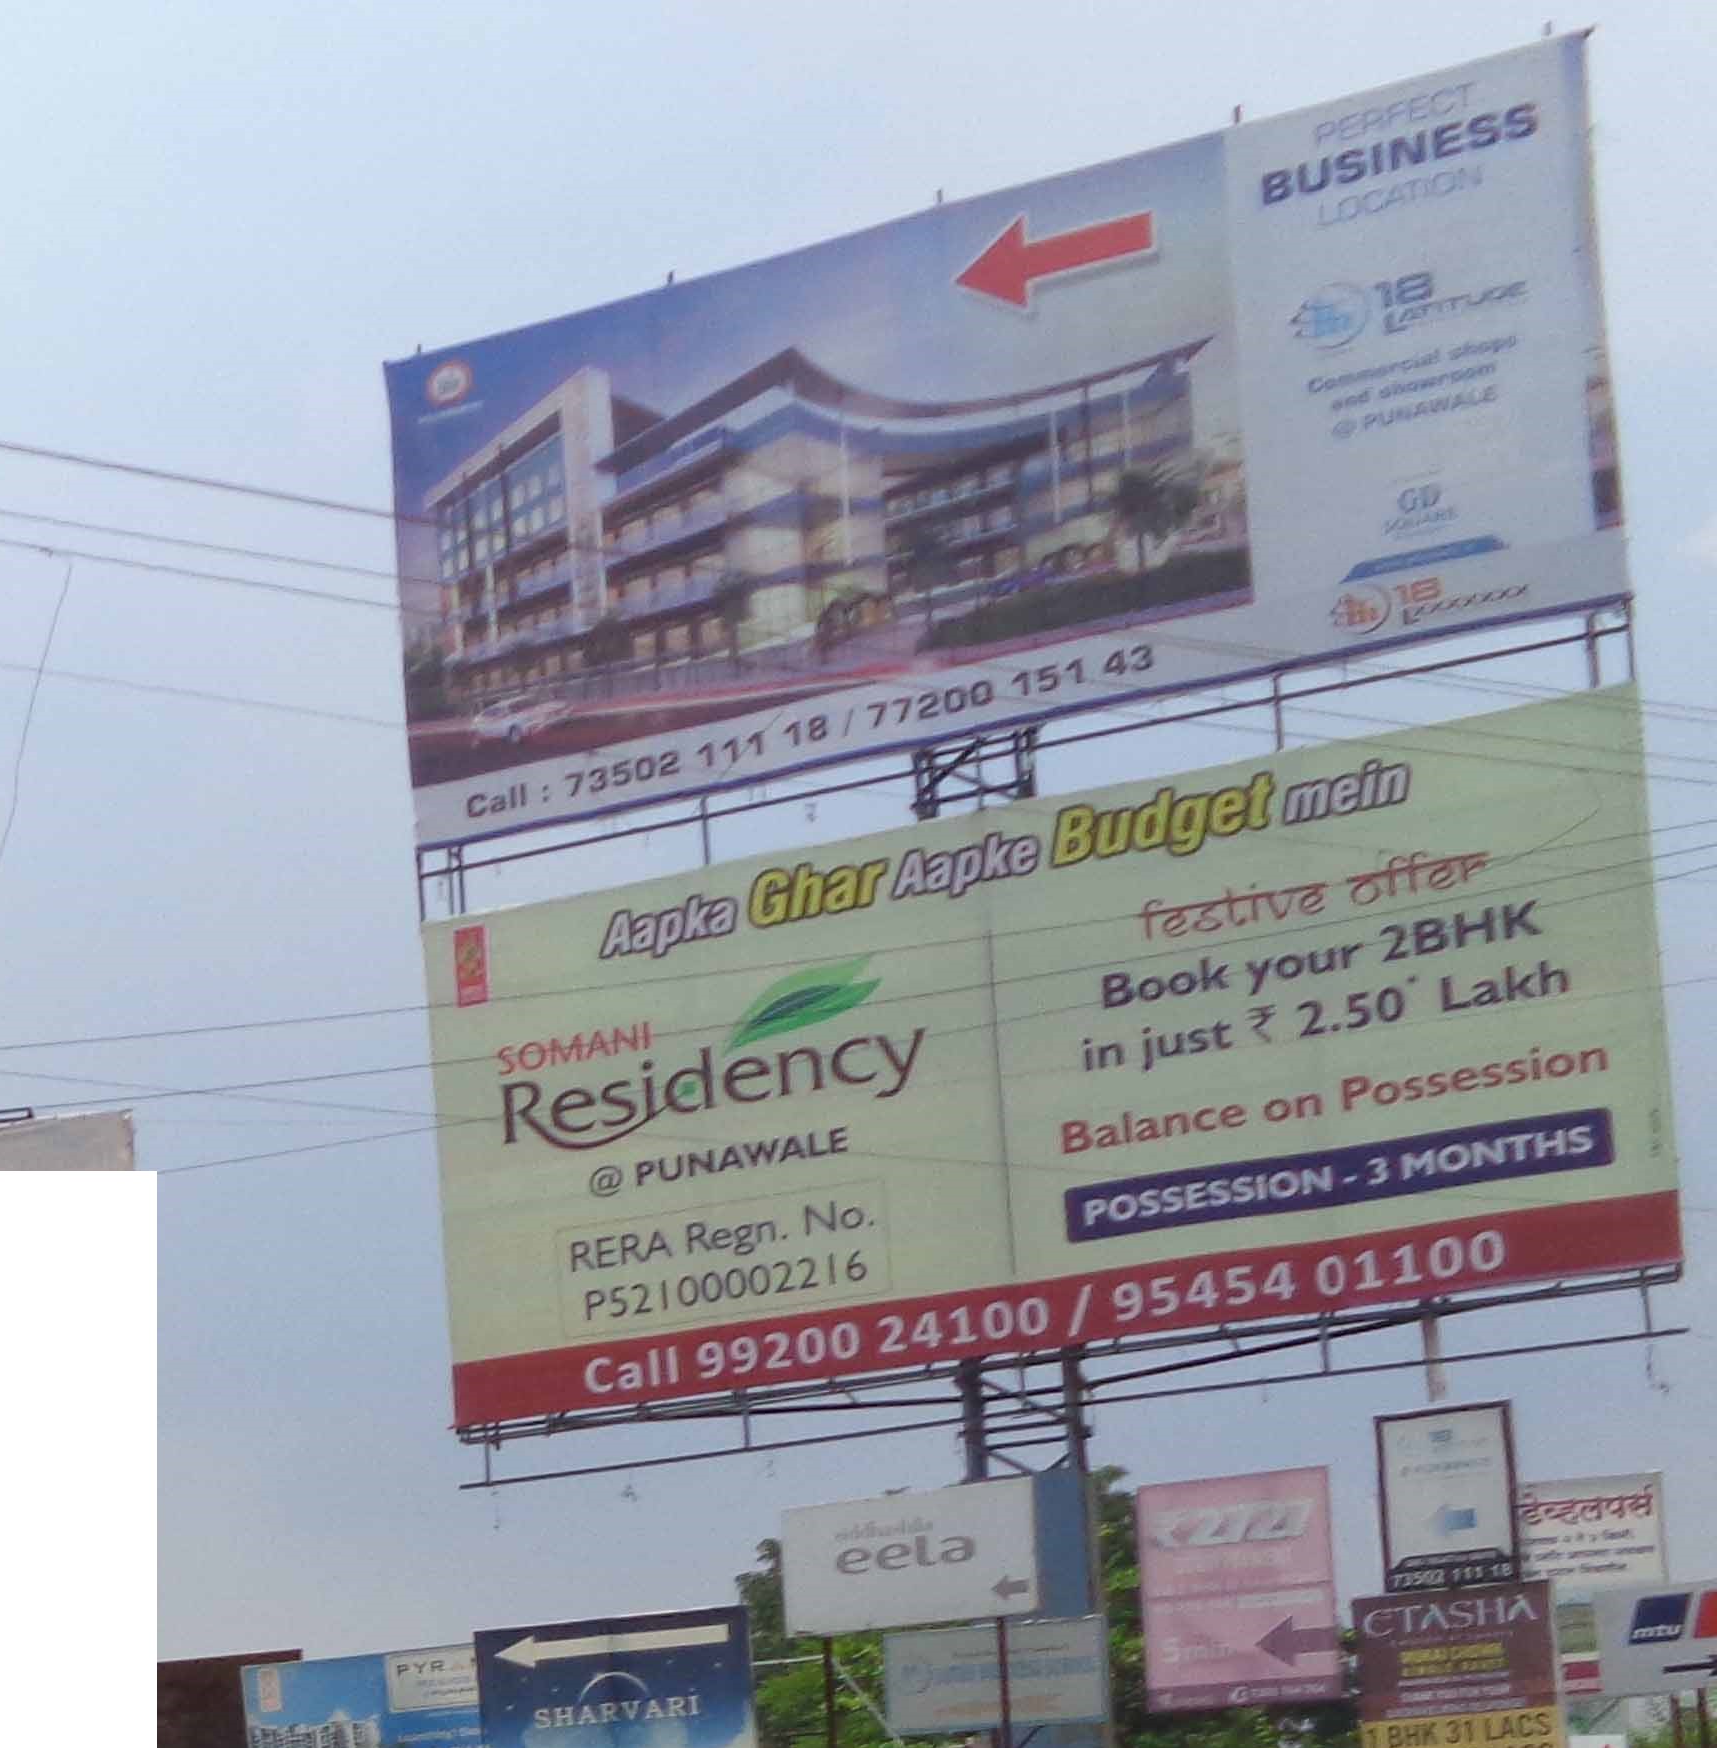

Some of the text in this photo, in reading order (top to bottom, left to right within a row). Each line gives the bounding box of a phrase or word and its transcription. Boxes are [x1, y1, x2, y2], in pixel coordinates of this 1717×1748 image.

[1262, 102, 1539, 206] BUSINESS
[1317, 82, 1475, 144] PERFECT
[467, 644, 1155, 819] Call 73502 111 18 77200 151 43
[599, 758, 1412, 960] Aapka Ghar Aapke Budget mein
[1136, 850, 1492, 940] festive offer
[1101, 899, 1543, 1011] Book your 2BHK
[498, 1021, 654, 1078] SOMANI
[1083, 959, 1571, 1073] in just Lakh
[500, 1027, 927, 1151] Residency
[1061, 1045, 1611, 1156] Balance on Possession
[635, 1126, 849, 1188] PUNAWALE
[1082, 1165, 1333, 1227] POSSESSION
[1367, 1159, 1388, 1187] 3
[1400, 1124, 1595, 1181] MONTHS
[569, 1200, 875, 1274] RERA Regn. No.
[583, 1228, 1507, 1397] Call 99200 24100 95454 01100
[584, 1249, 869, 1322] P52100002216
[1631, 1623, 1682, 1641] mtu
[533, 1694, 702, 1730] SHARVARI
[1388, 1721, 1438, 1748] BHK
[1446, 1719, 1474, 1745] 31
[1485, 1711, 1551, 1741] LACS
